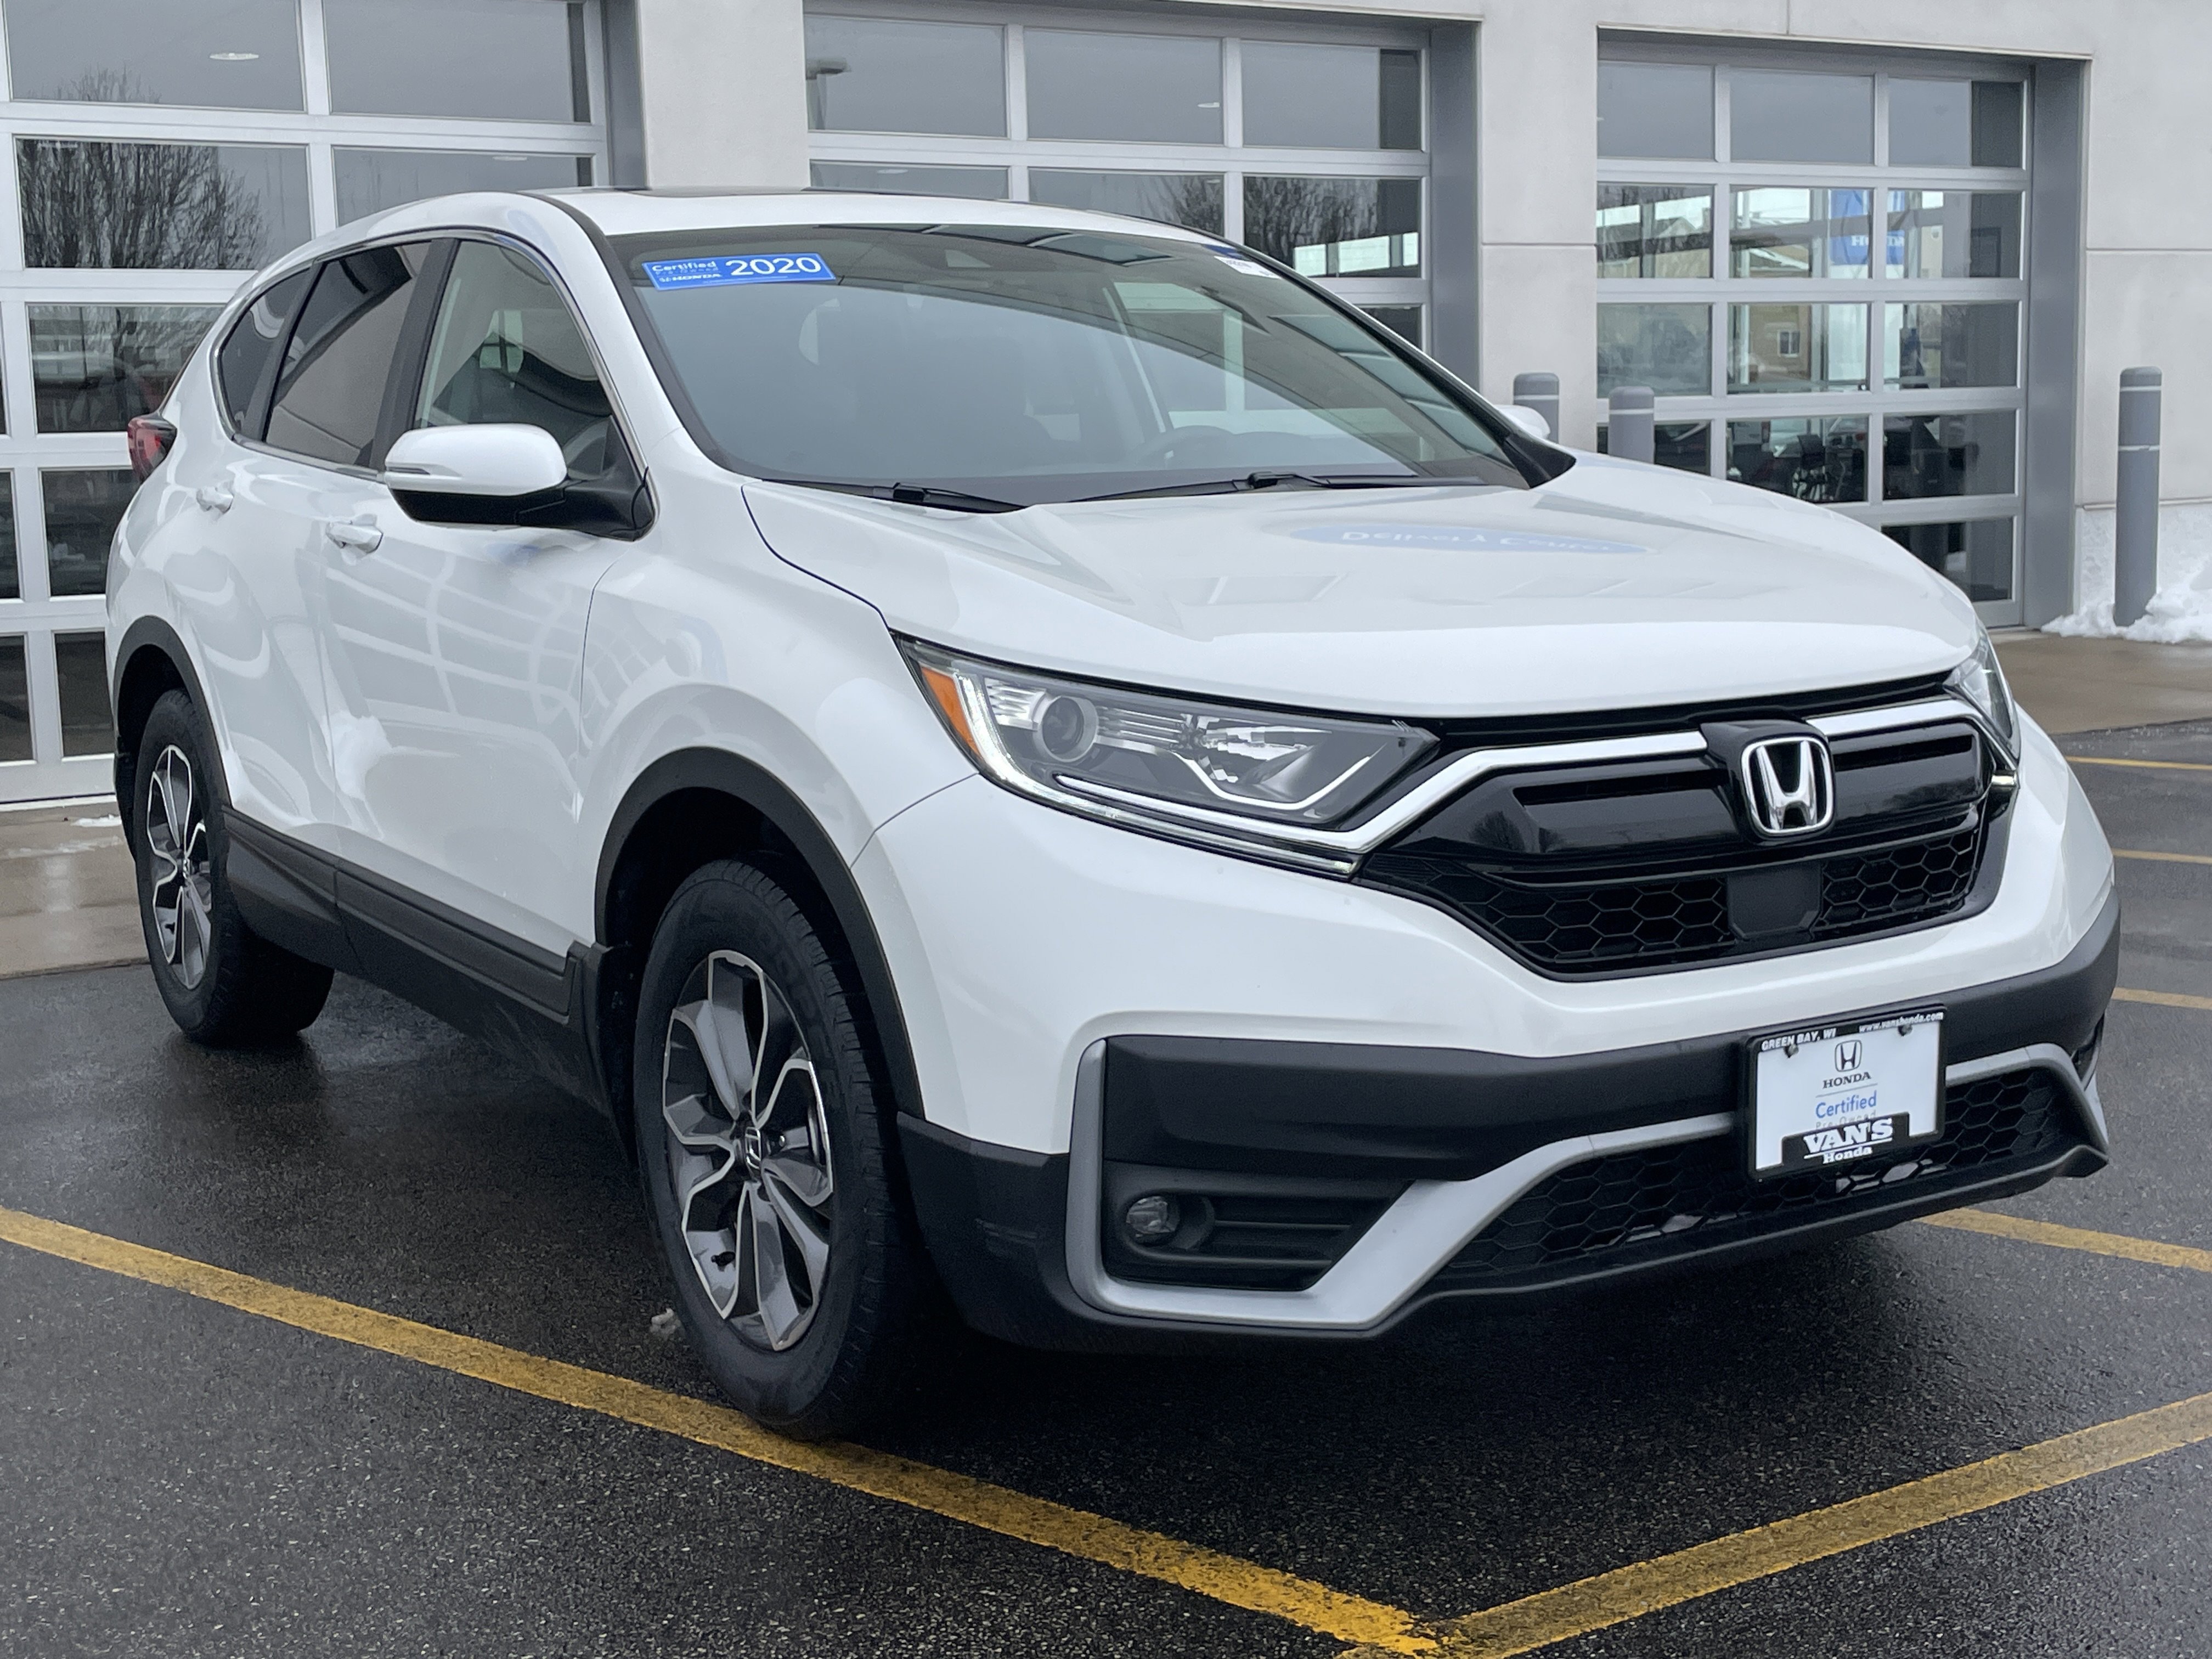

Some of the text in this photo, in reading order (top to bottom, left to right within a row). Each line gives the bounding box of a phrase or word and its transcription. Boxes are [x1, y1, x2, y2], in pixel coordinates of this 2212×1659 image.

[651, 261, 717, 272] Certified
[725, 256, 822, 276] 2020
[1859, 1012, 1944, 1033] www.vanshonda.com
[1761, 1028, 1837, 1051] GREEN BAY, WI
[1822, 1071, 1872, 1088] HONDA
[1815, 1090, 1877, 1119] Certified
[1803, 1118, 1894, 1153] VAN'S
[1822, 1146, 1873, 1164] Honda
